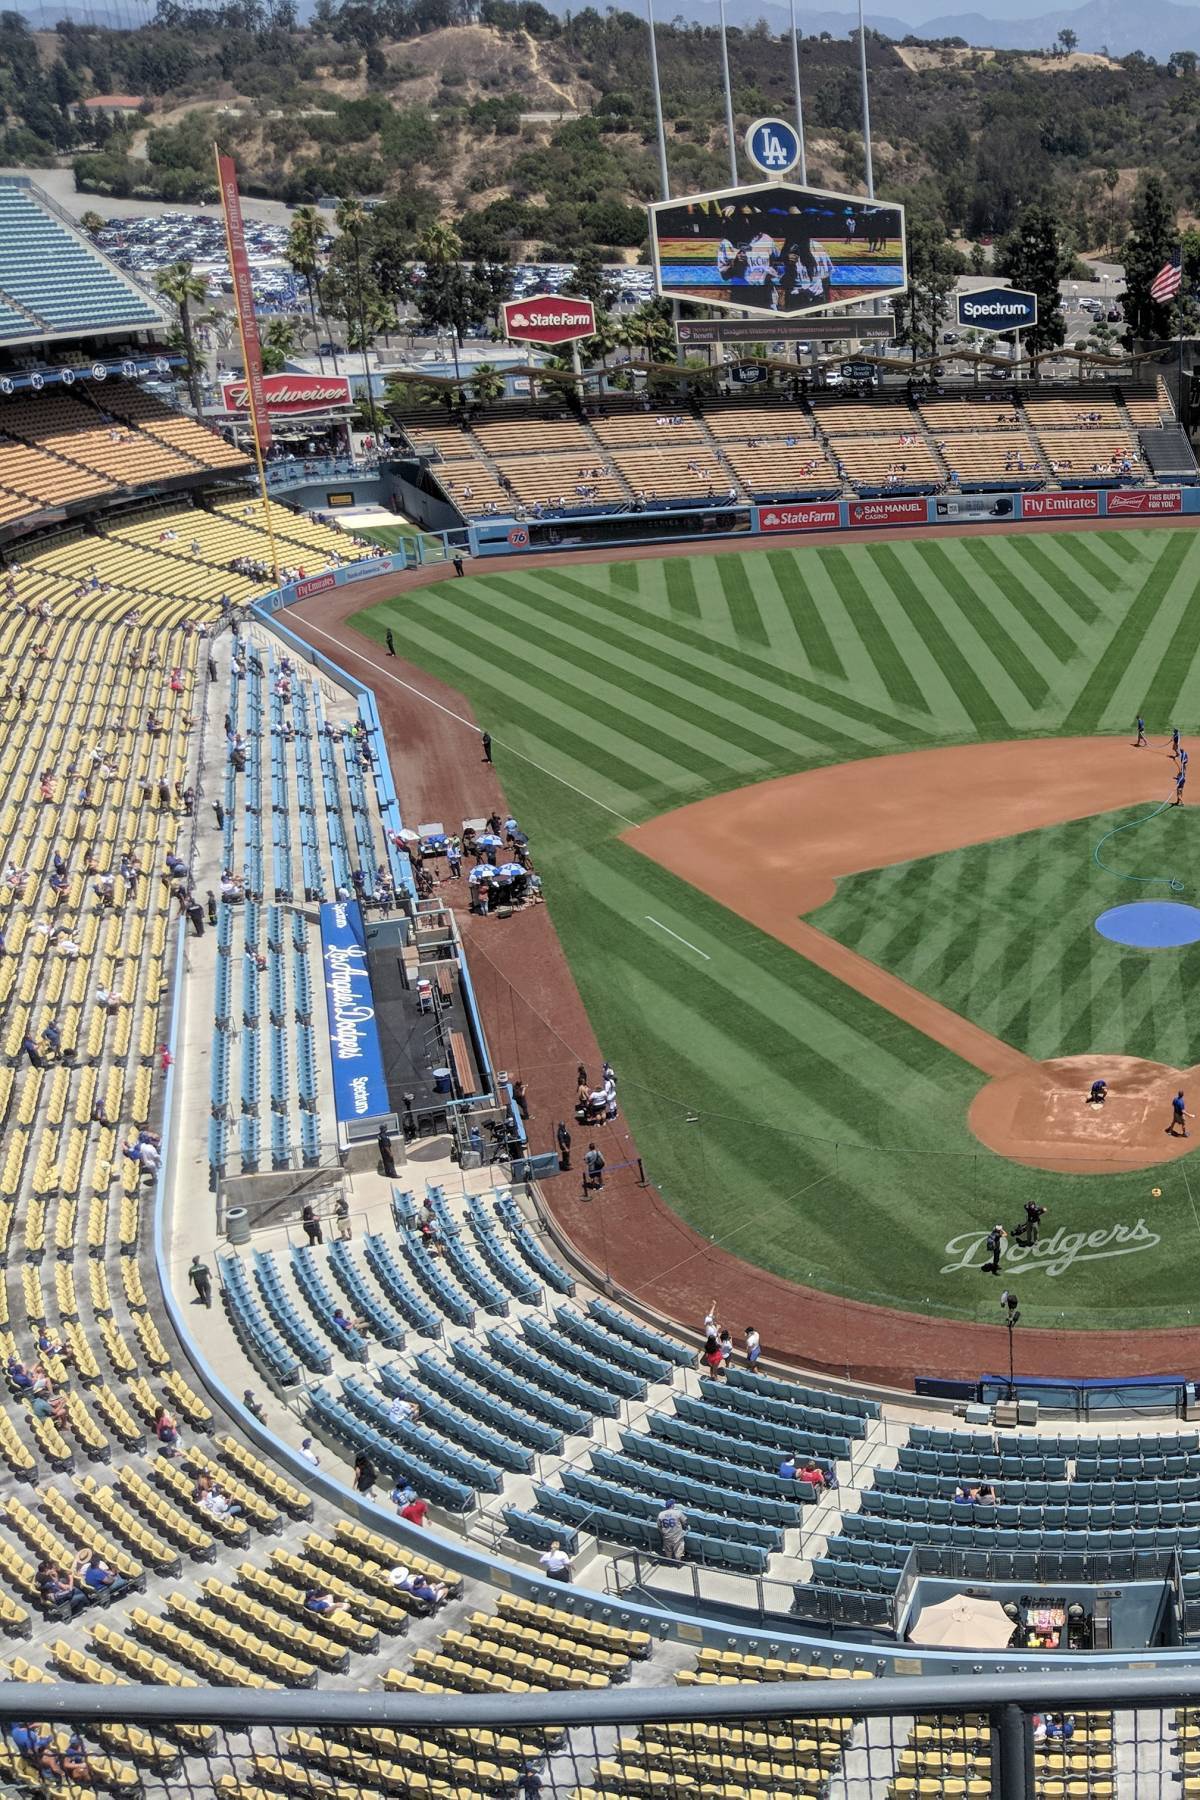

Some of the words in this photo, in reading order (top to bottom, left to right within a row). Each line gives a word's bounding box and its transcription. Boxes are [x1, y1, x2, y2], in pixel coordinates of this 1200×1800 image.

[762, 128, 787, 165] LA
[239, 273, 252, 319] Emirates
[963, 302, 1026, 319] Spectrum
[245, 320, 254, 338] Fly
[94, 366, 106, 377] 42
[250, 361, 264, 405] Emirates
[864, 504, 884, 514] SAN
[885, 503, 923, 513] MANUEL
[1024, 499, 1044, 513] Fly
[1045, 497, 1097, 510] Emirates
[864, 513, 889, 521] CASINO
[511, 534, 527, 544] 76
[297, 583, 308, 596] Fly
[308, 577, 335, 591] Emirates
[326, 963, 369, 1011] Angeles
[331, 1006, 374, 1060] Dodgers
[349, 1076, 369, 1114] Spectrum
[939, 1218, 1161, 1277] Dodgers
[662, 1518, 676, 1528] 66
